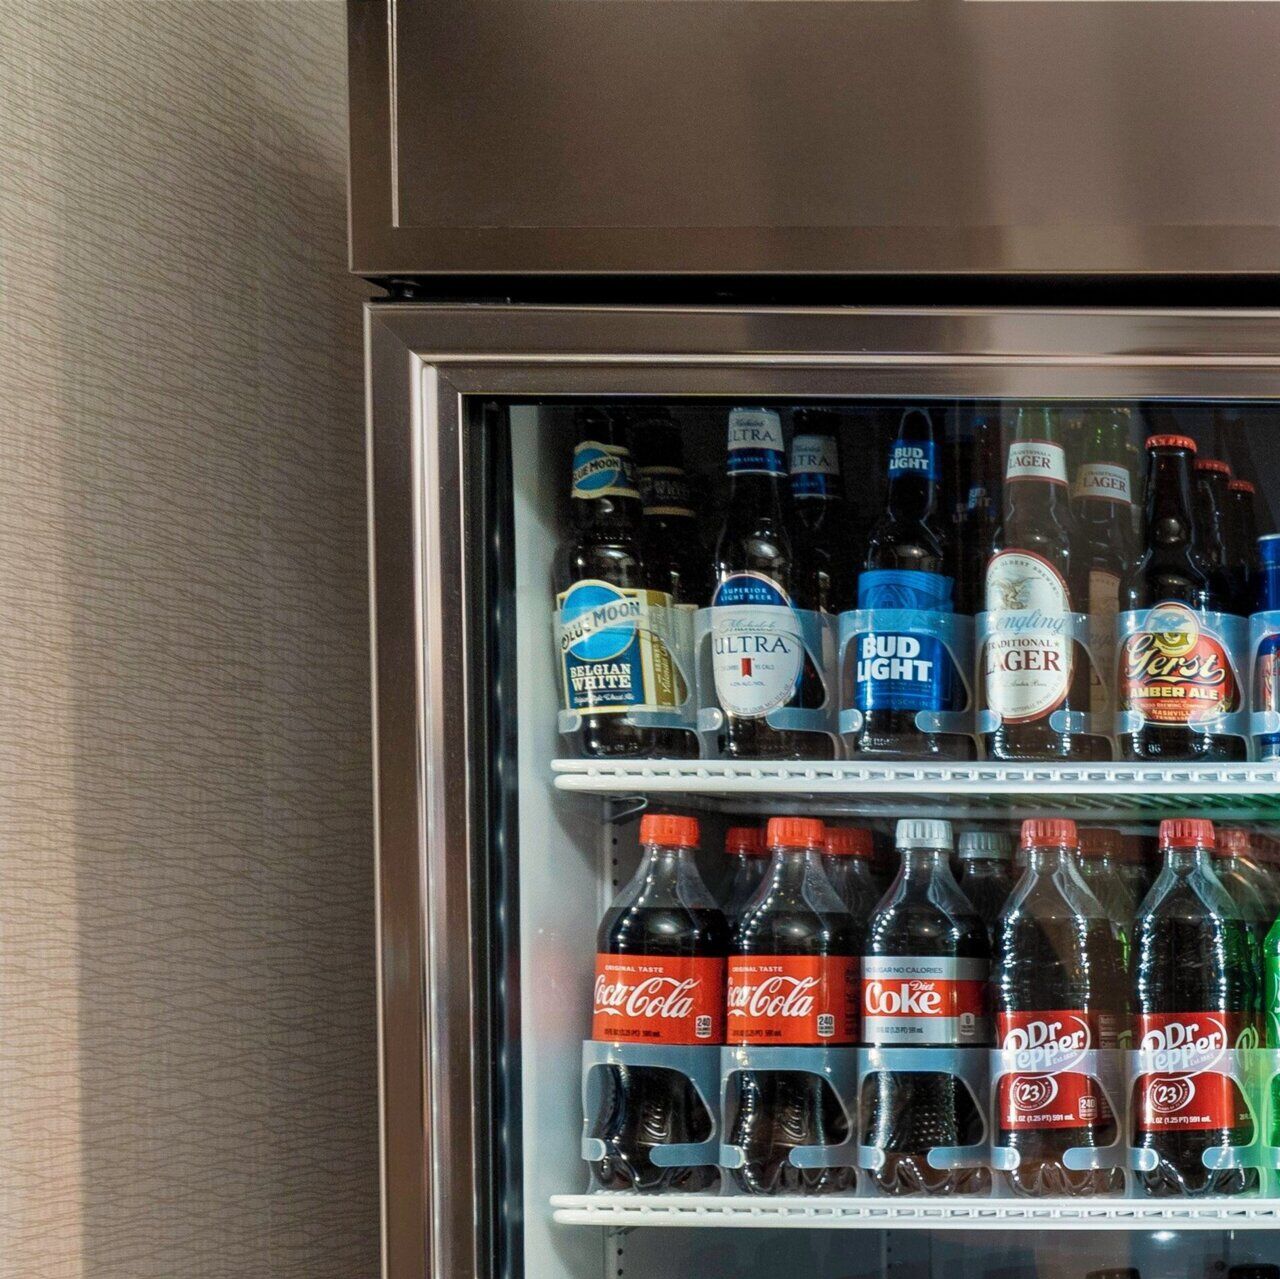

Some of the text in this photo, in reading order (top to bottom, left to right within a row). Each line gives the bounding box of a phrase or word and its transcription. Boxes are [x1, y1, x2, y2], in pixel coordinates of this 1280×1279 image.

[895, 448, 923, 459] BUD
[890, 459, 928, 470] LIGHT
[1009, 455, 1051, 469] LAGER
[715, 636, 788, 656] ULTRA
[862, 637, 920, 659] BUD
[1124, 635, 1225, 680] Gerst
[570, 663, 631, 677] BELGIAN
[857, 660, 932, 682] LIGHT
[571, 675, 631, 691] WHITE
[1131, 688, 1217, 699] AMBER ALE
[910, 980, 935, 991] Diet
[866, 982, 940, 1014] Coke
[1021, 1084, 1039, 1101] 23
